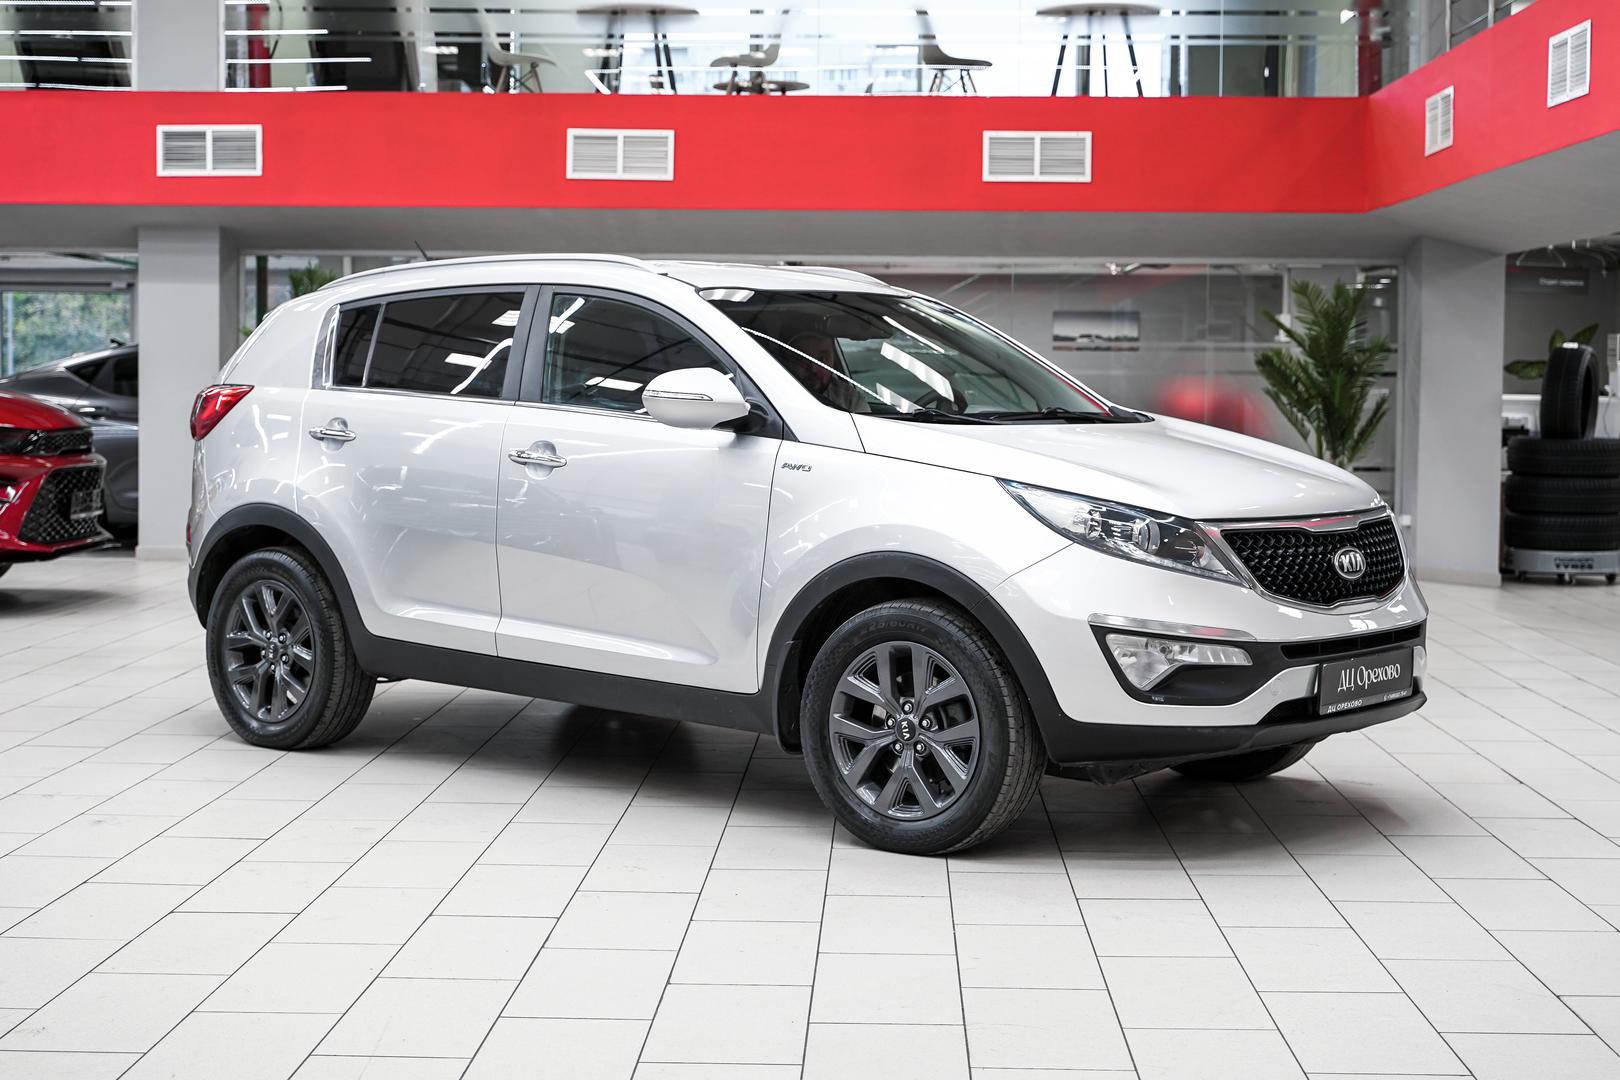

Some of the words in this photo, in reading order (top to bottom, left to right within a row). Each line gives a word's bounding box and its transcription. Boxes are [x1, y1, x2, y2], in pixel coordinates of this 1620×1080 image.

[1340, 552, 1364, 572] KIA
[1337, 668, 1355, 693] ДЦ
[1357, 663, 1401, 690] Орехово
[1337, 699, 1363, 711] ОРЕХОВО
[901, 720, 910, 740] KIA
